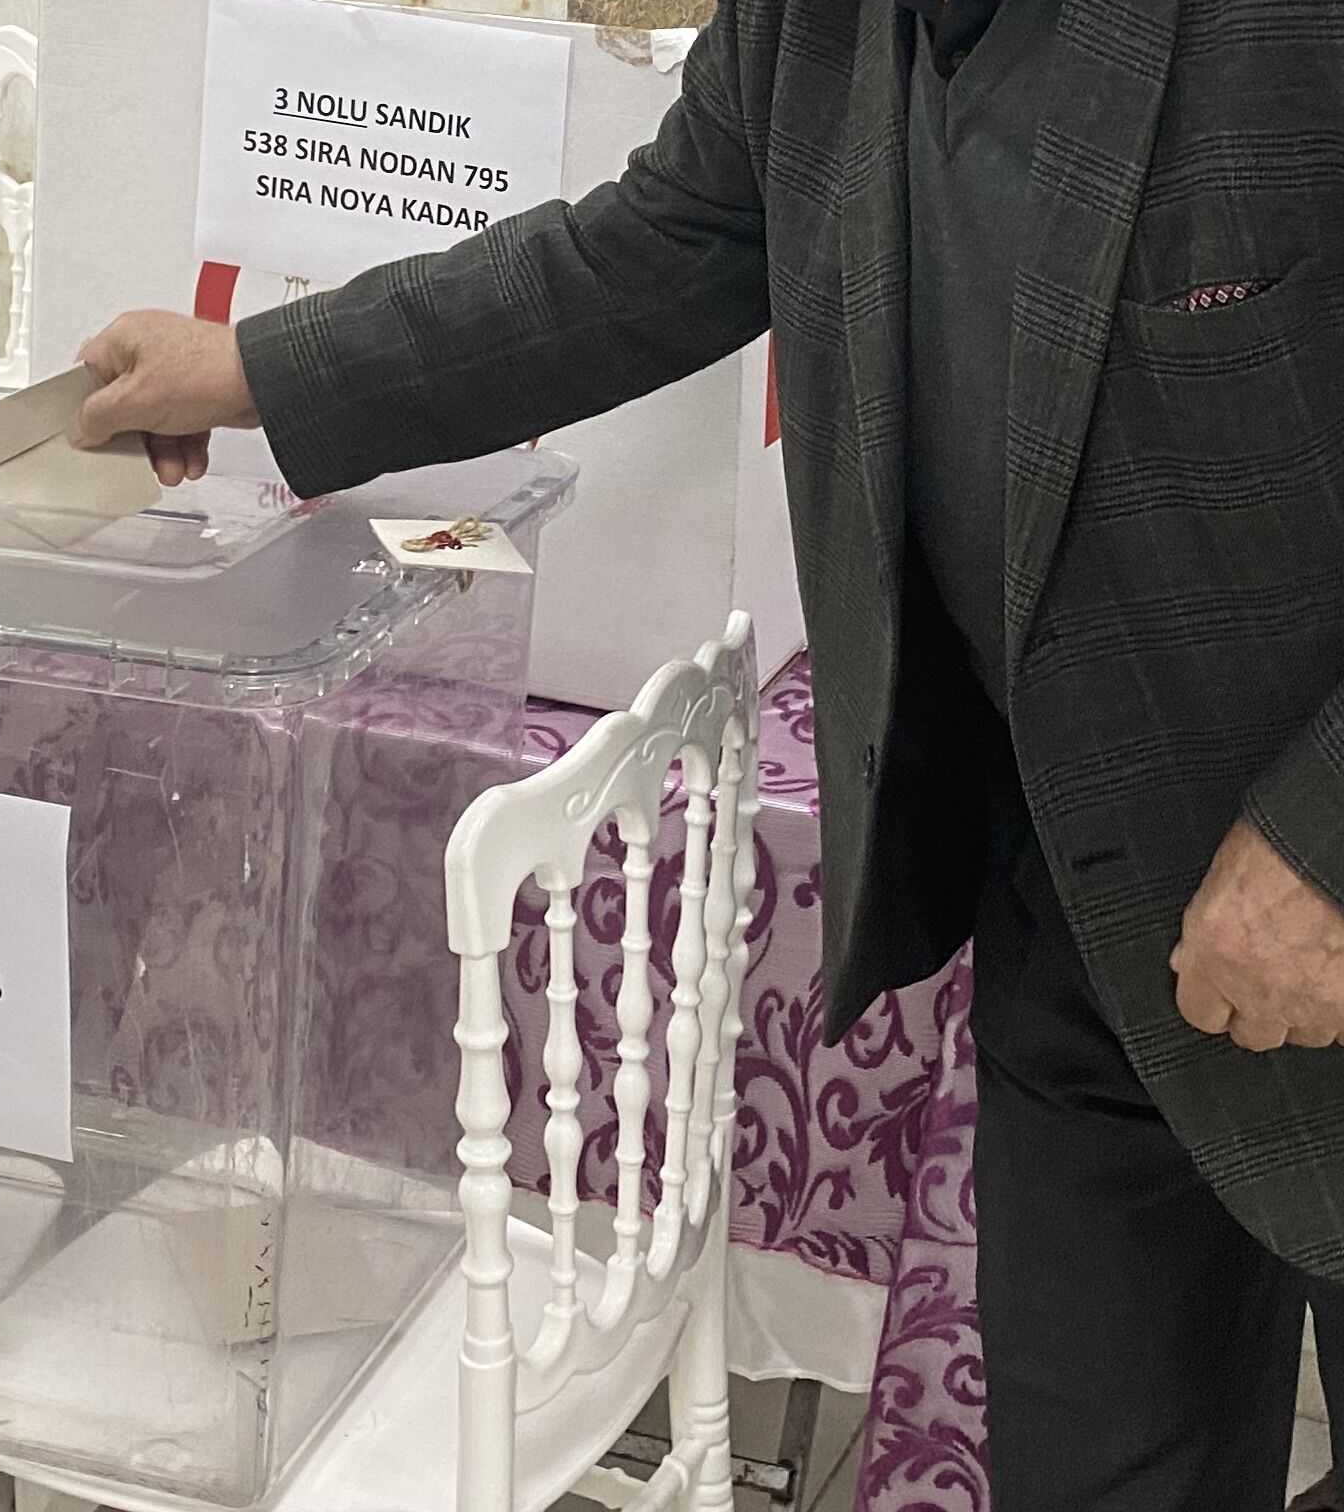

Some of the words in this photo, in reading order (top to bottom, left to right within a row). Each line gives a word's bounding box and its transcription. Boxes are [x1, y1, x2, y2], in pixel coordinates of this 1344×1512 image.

[274, 87, 289, 111] 3
[297, 91, 368, 123] NOLU
[375, 103, 472, 139] SANDIK
[243, 129, 288, 157] 538
[295, 138, 352, 168] SIRA
[360, 147, 455, 184] NODAN
[464, 164, 509, 193] 795
[256, 174, 312, 204] SIRA
[320, 184, 394, 218] NOYA
[401, 197, 490, 232] KADAR
